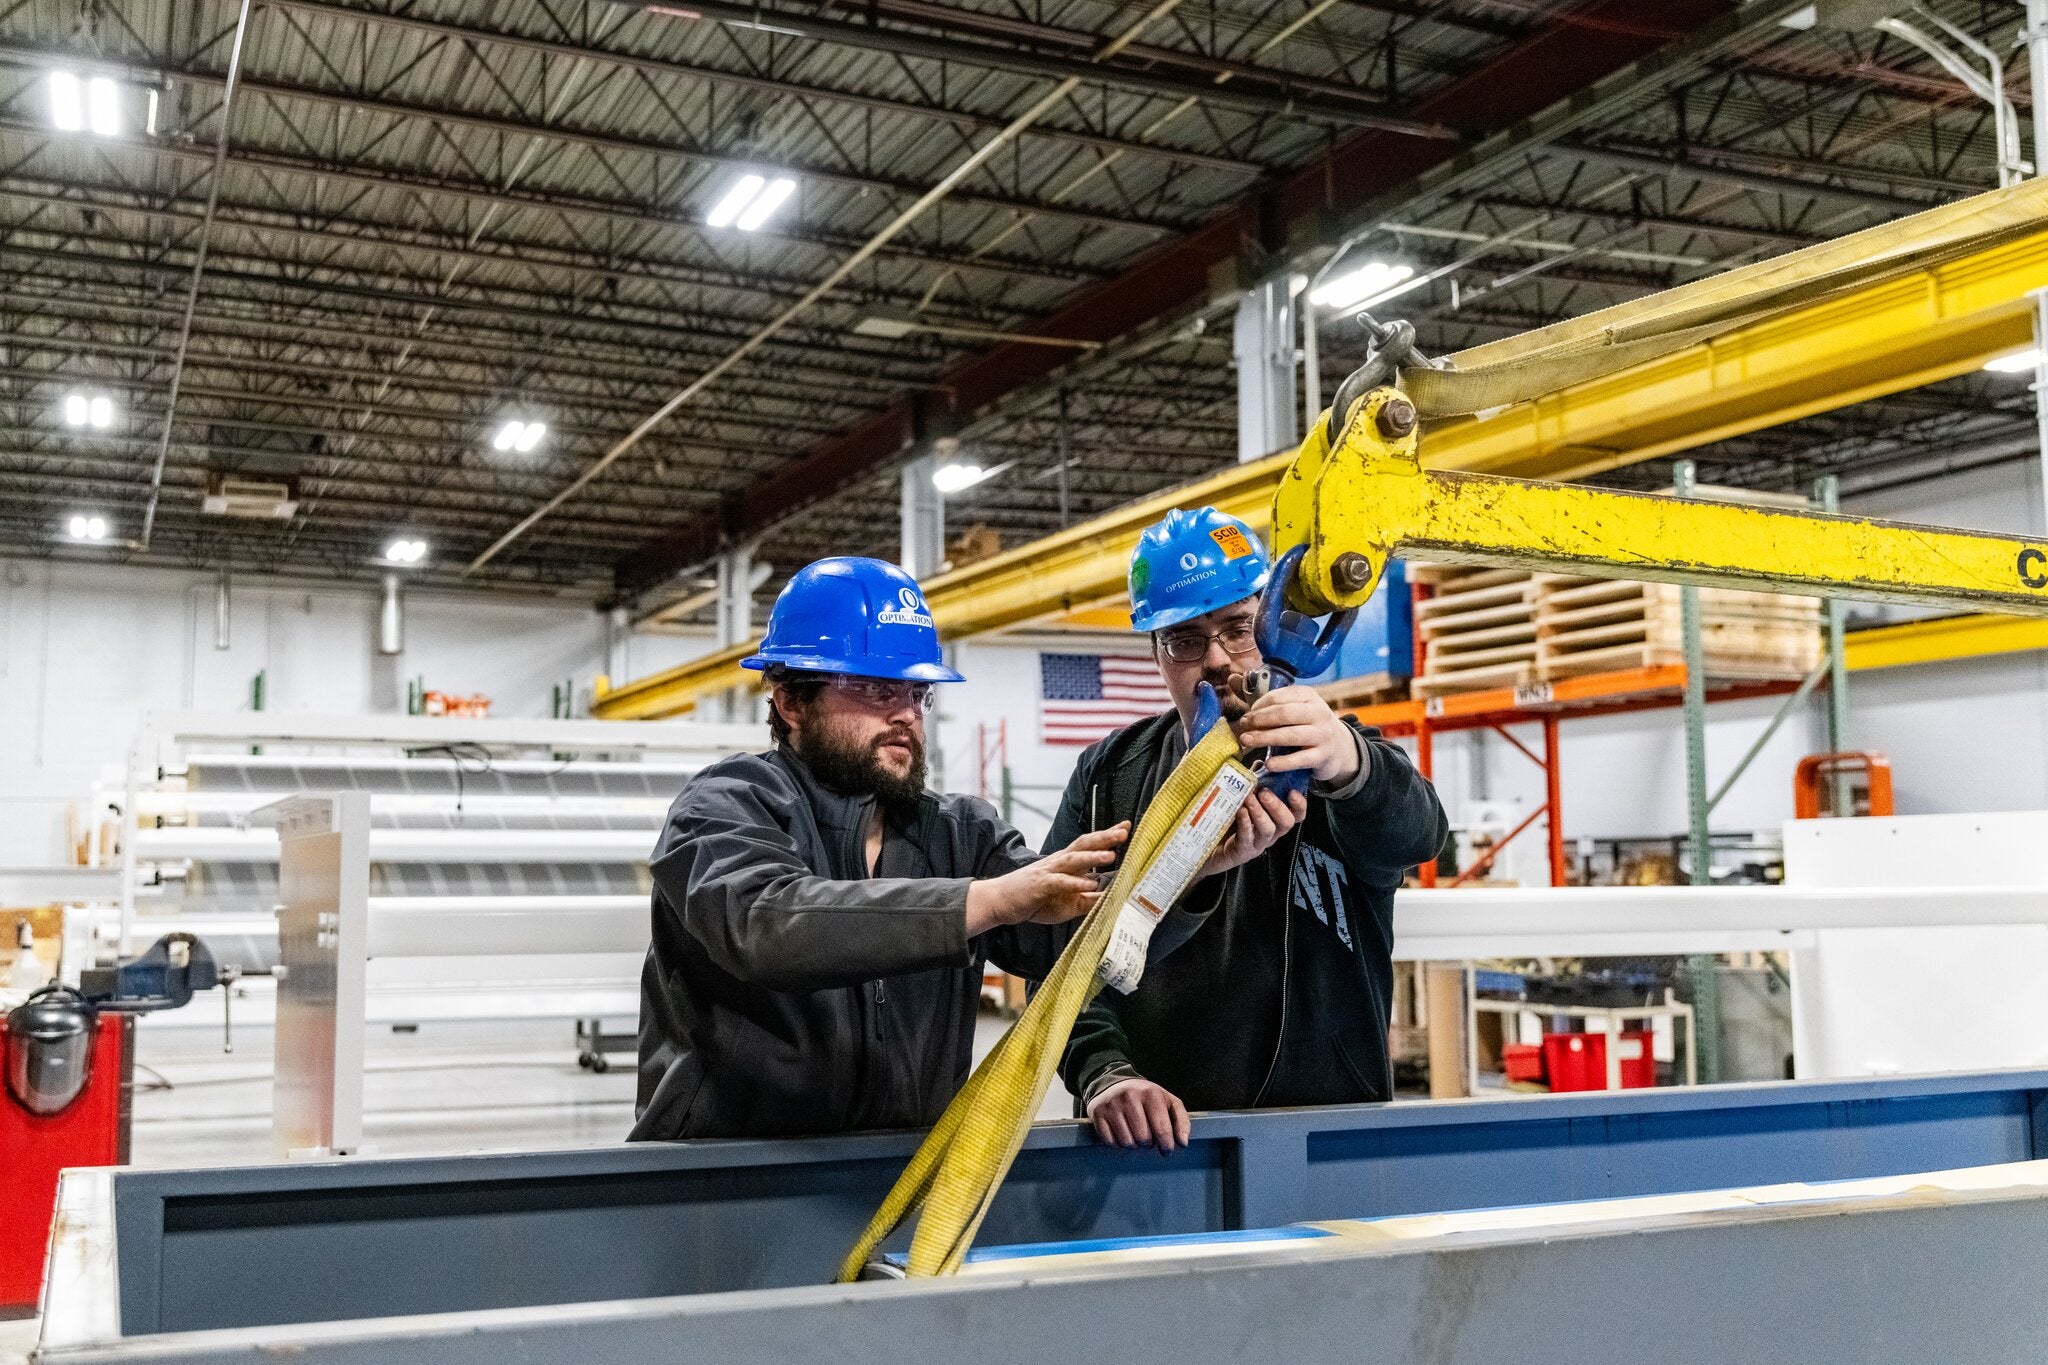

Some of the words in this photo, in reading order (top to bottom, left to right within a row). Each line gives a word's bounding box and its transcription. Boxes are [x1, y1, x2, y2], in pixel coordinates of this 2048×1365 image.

[1213, 526, 1239, 540] SCID
[1166, 569, 1217, 593] OPTIMATION
[1227, 775, 1245, 792] HSI
